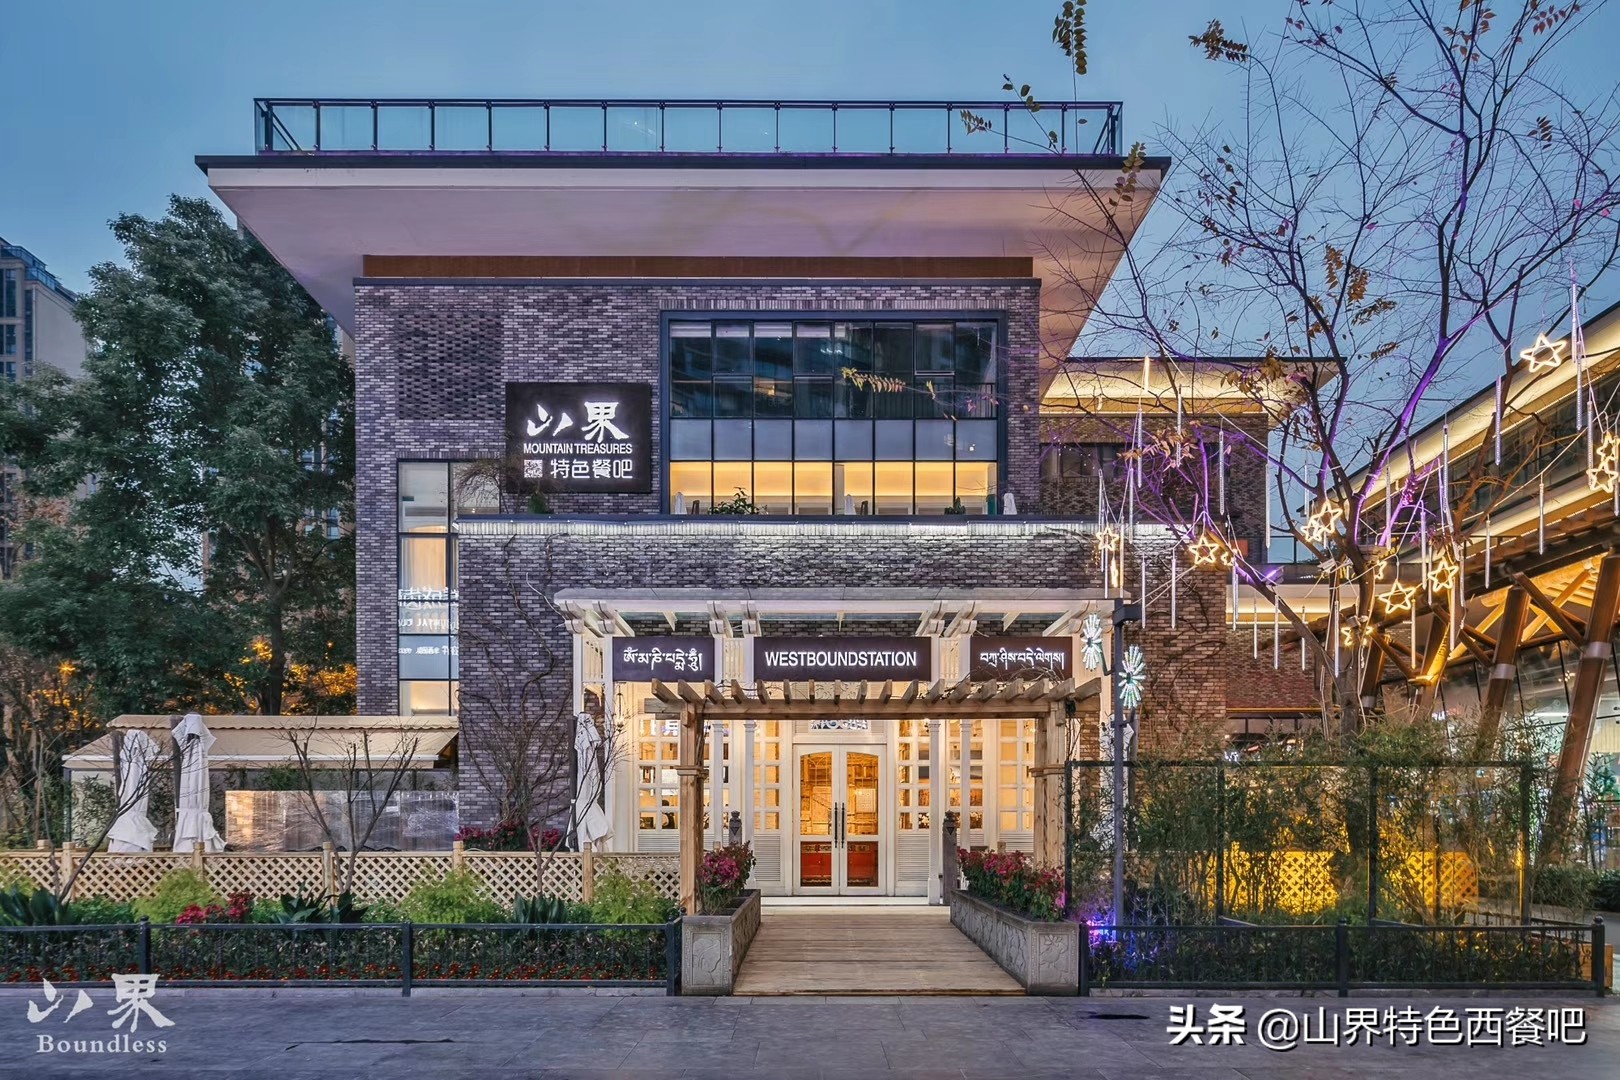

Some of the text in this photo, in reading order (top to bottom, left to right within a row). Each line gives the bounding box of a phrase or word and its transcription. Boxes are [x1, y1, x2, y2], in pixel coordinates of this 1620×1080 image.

[523, 443, 633, 455] MOUNTAIN TREASURES
[550, 459, 633, 479] 特色餐吧
[765, 651, 917, 667] WESTBOUNDSTATION
